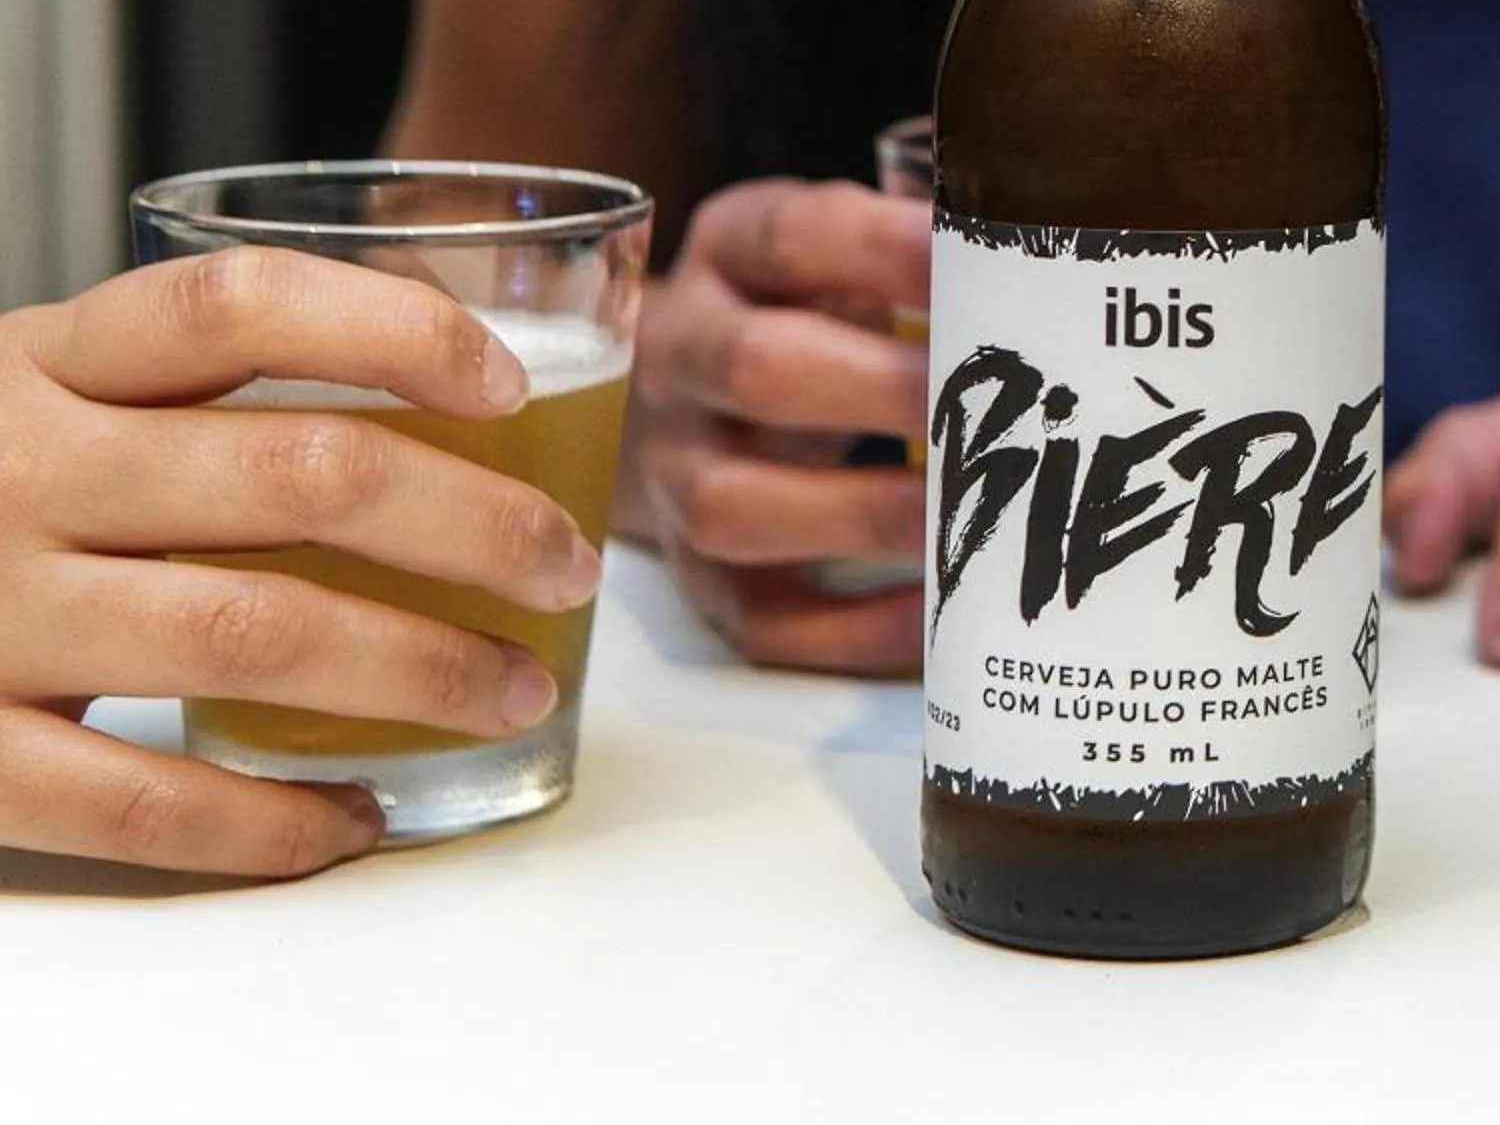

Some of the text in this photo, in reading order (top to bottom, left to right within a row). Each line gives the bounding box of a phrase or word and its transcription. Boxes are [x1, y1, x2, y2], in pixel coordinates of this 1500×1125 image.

[1105, 286, 1215, 347] ibis
[985, 655, 1323, 690] CERVEJA PURO MALTE
[983, 688, 1039, 716] COM
[1055, 695, 1185, 723] LÚPULO
[1201, 685, 1328, 722] FRANCÊS
[1082, 742, 1219, 763] 355 mL
